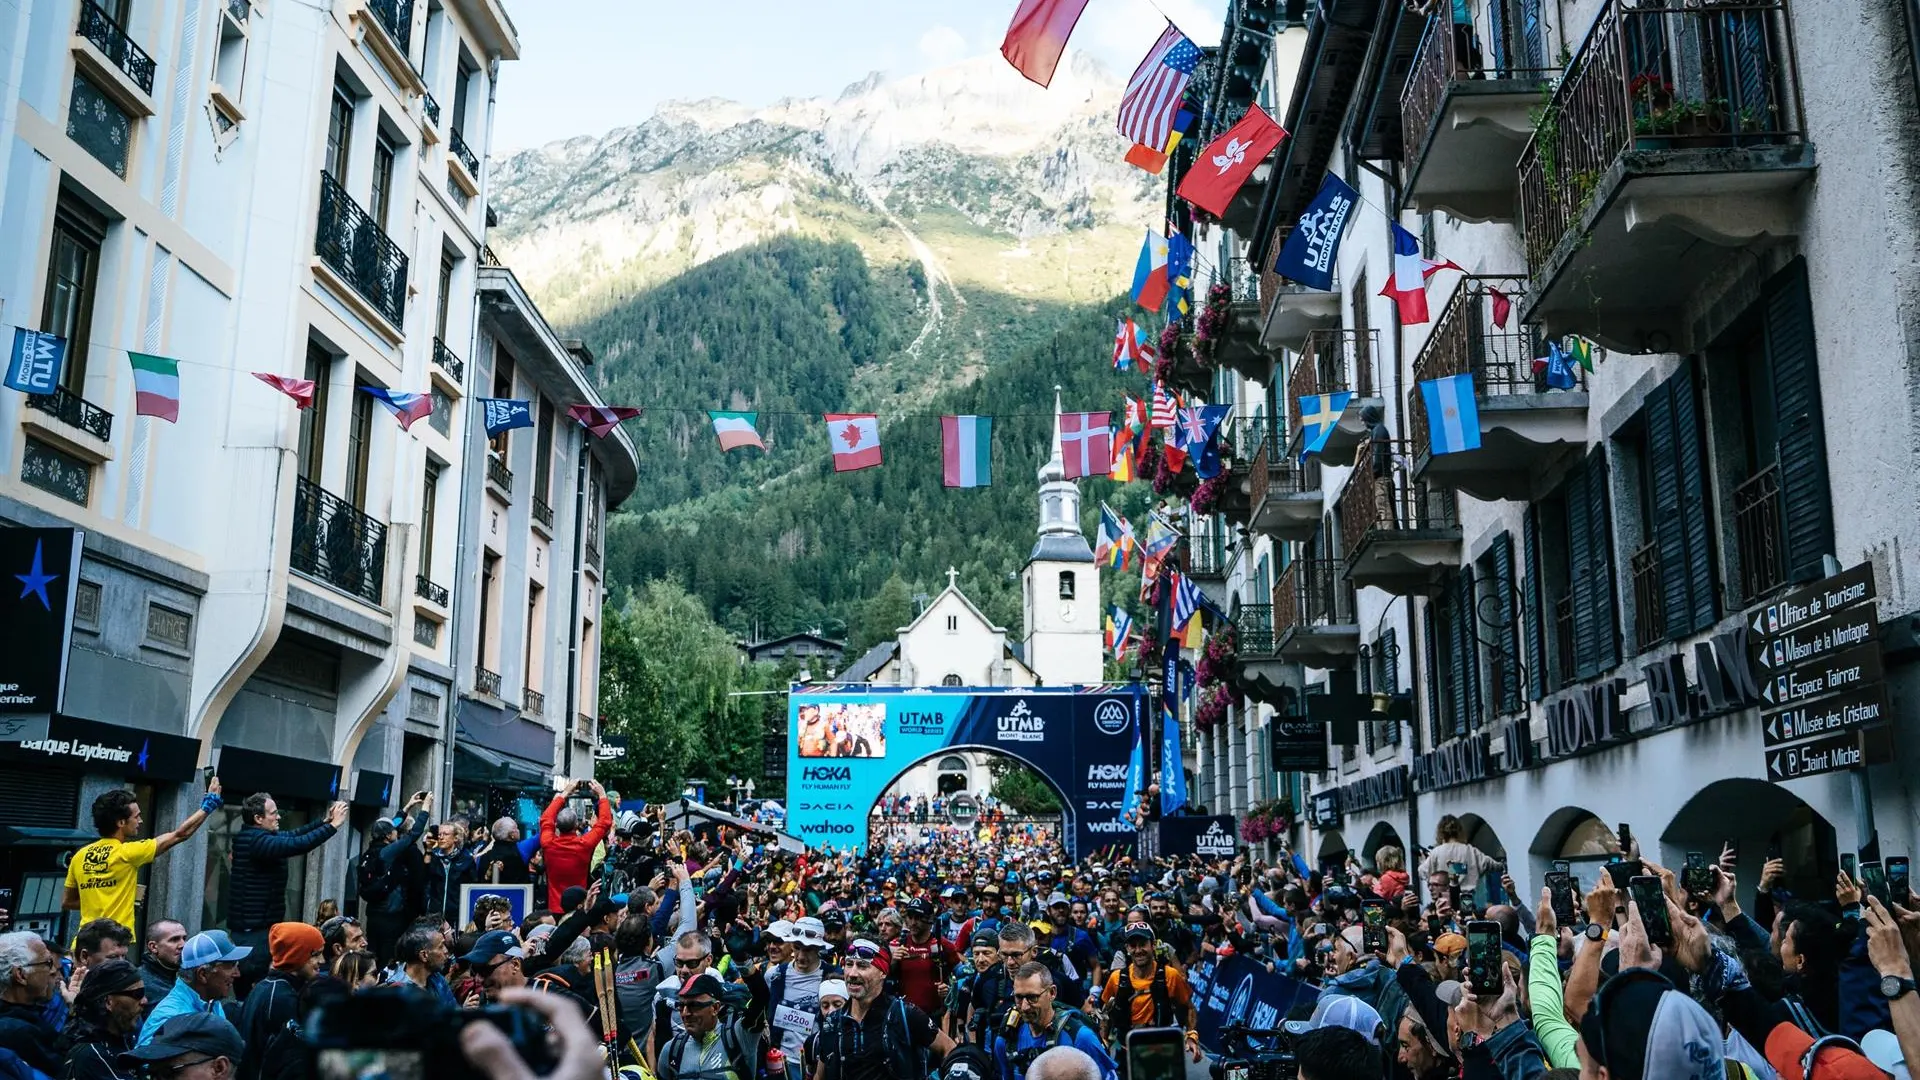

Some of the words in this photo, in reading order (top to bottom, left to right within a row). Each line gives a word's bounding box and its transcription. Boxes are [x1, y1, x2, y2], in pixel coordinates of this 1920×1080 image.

[1303, 194, 1343, 268] UTMB
[1780, 601, 1808, 628] Office
[1810, 597, 1821, 616] de
[1824, 582, 1865, 610] Tourisme
[1785, 635, 1812, 663] Maison
[1813, 635, 1822, 653] de
[1824, 631, 1831, 650] la
[1832, 622, 1869, 647] Montagne
[1790, 672, 1823, 699] Espace
[1826, 666, 1860, 688] Tairraz
[900, 712, 944, 725] UTMB
[997, 716, 1044, 731] UTMB
[1794, 708, 1824, 736] Musée
[1826, 710, 1840, 728] des
[1843, 702, 1879, 724] Cristaux
[1414, 735, 1487, 792] PHARMACIE
[1503, 717, 1527, 771] DU
[1545, 679, 1619, 759] MONT
[71, 739, 132, 763] Laydernier
[1788, 752, 1797, 773] P
[1802, 746, 1828, 773] Saint
[1832, 746, 1860, 767] Miche
[803, 766, 851, 781] HOKA
[1086, 801, 1123, 809] DAC
[800, 819, 854, 834] wahoo
[1196, 834, 1234, 847] UTMB
[84, 851, 110, 864] RAID
